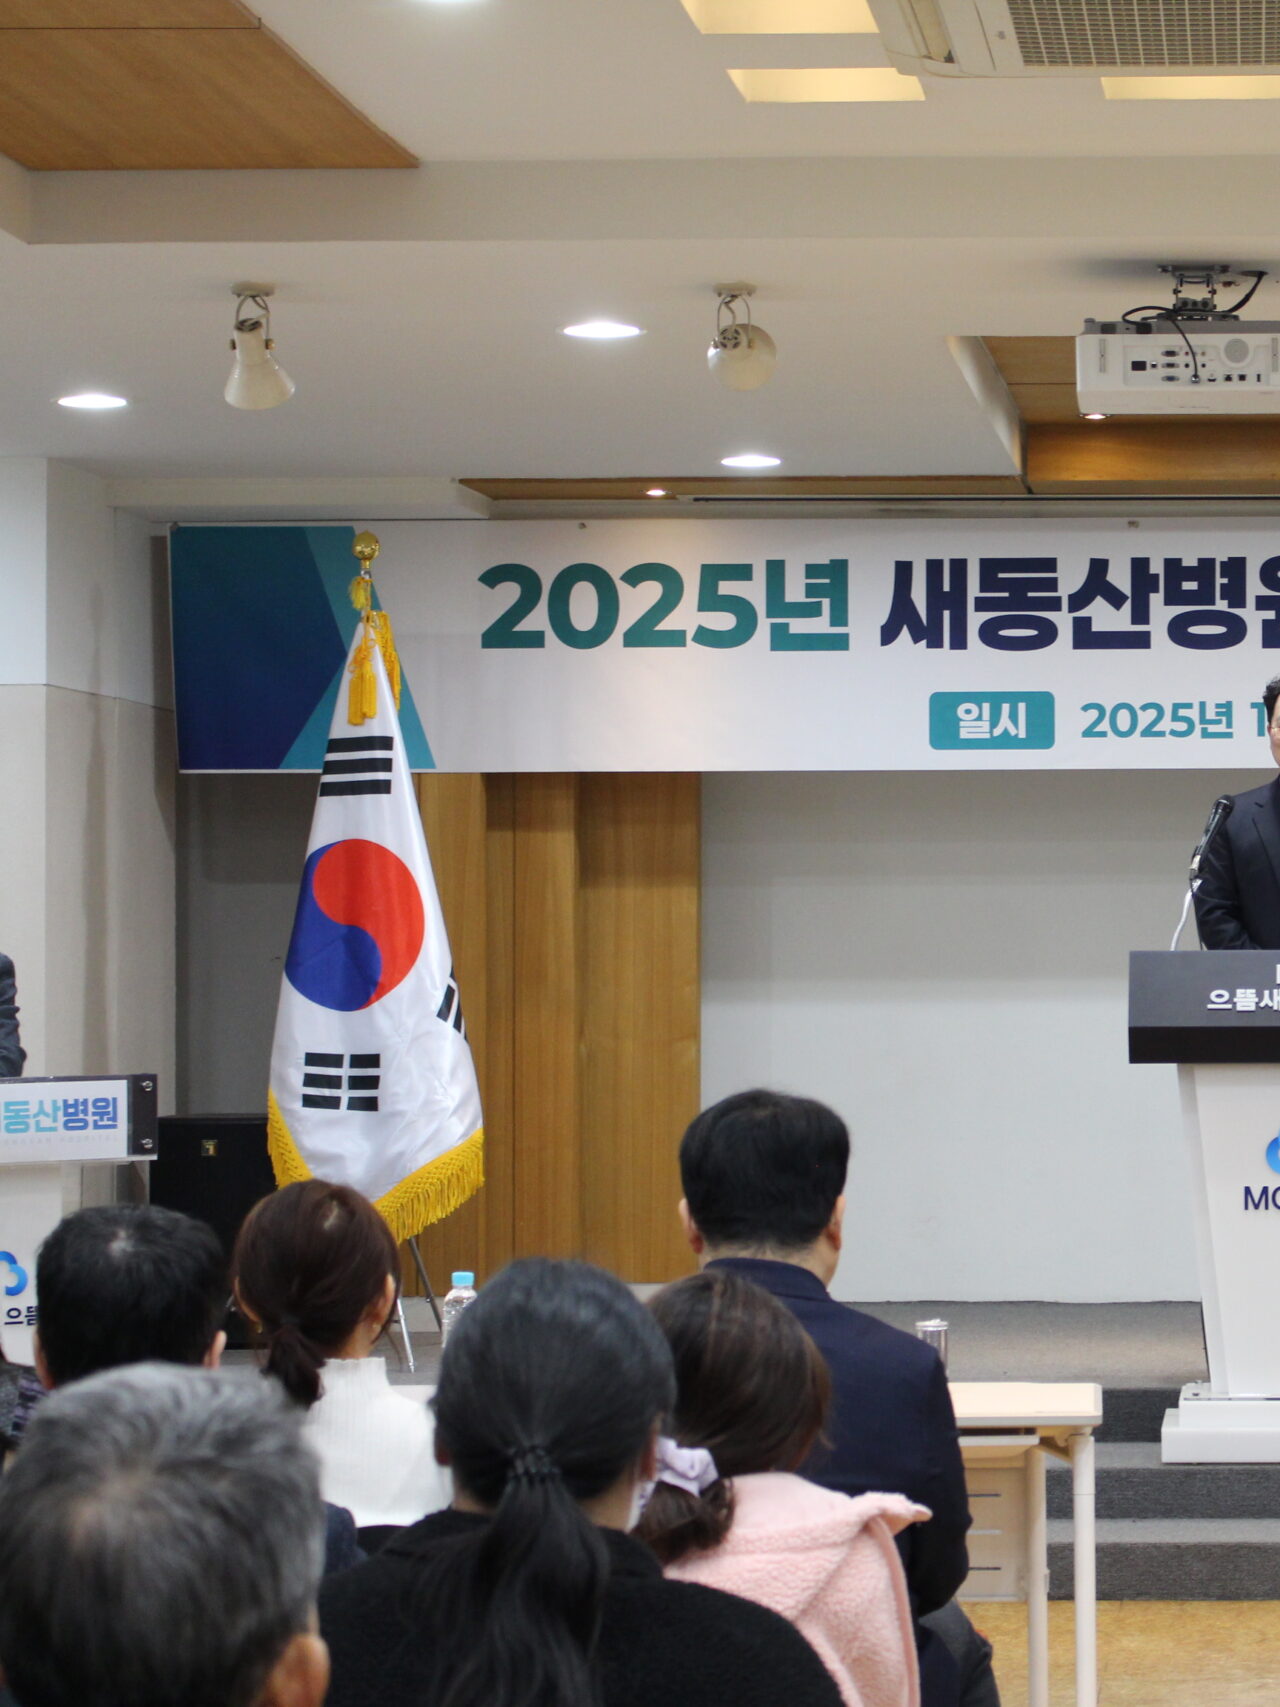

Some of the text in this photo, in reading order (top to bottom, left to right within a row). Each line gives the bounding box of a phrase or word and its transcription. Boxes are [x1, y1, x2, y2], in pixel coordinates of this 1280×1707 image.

[478, 559, 850, 652] 2025년
[956, 702, 1027, 739] 일시
[1080, 700, 1234, 739] 2025년
[0, 1097, 118, 1134] 동산병원
